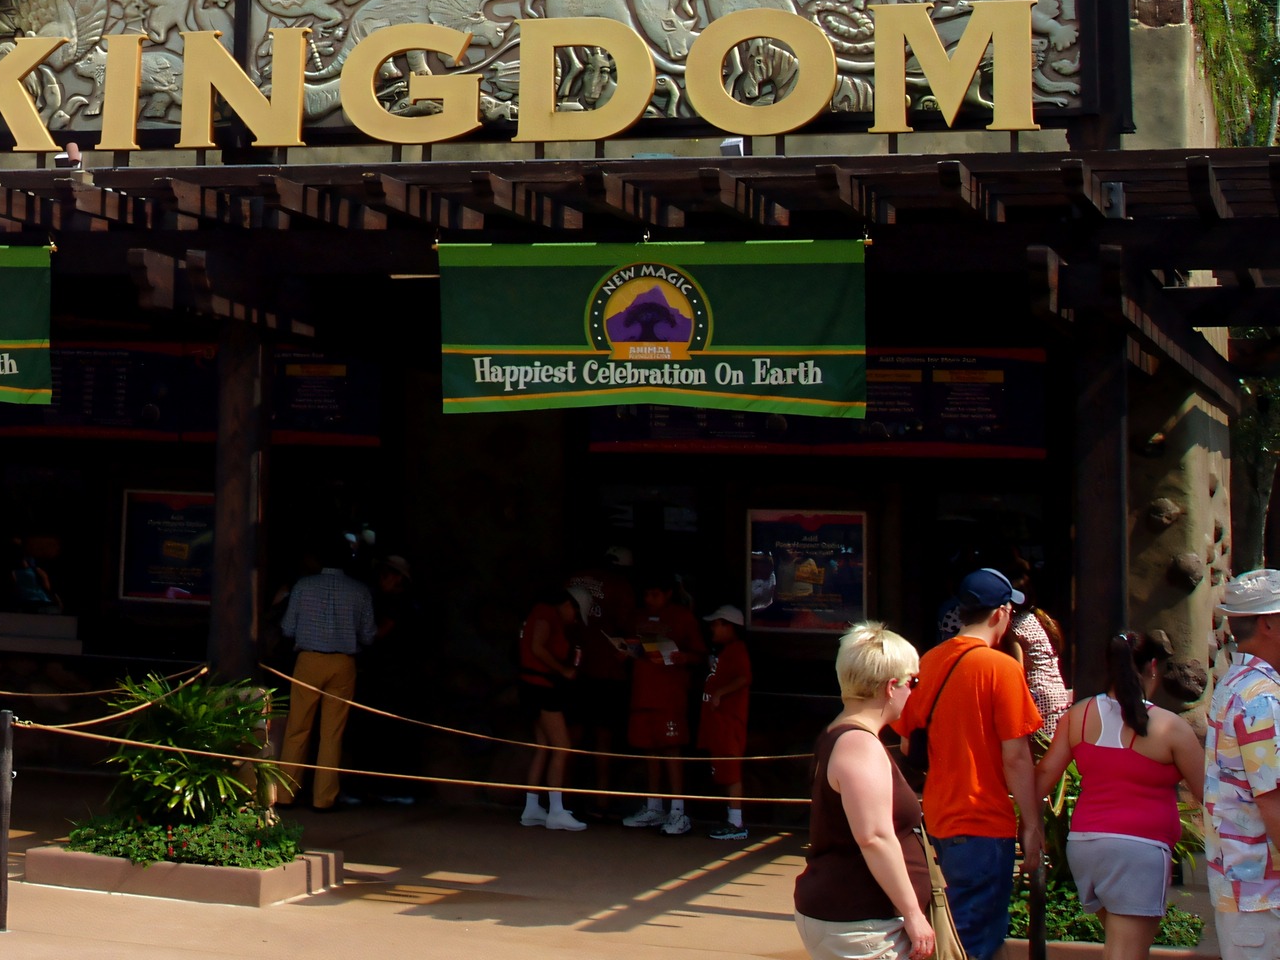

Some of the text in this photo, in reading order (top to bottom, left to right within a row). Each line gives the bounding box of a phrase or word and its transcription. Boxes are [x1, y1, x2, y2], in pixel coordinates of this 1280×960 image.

[602, 264, 693, 296] NEW MAGIC
[629, 346, 672, 354] ANIMAL
[472, 357, 822, 391] Happiest Celebration On Earth
